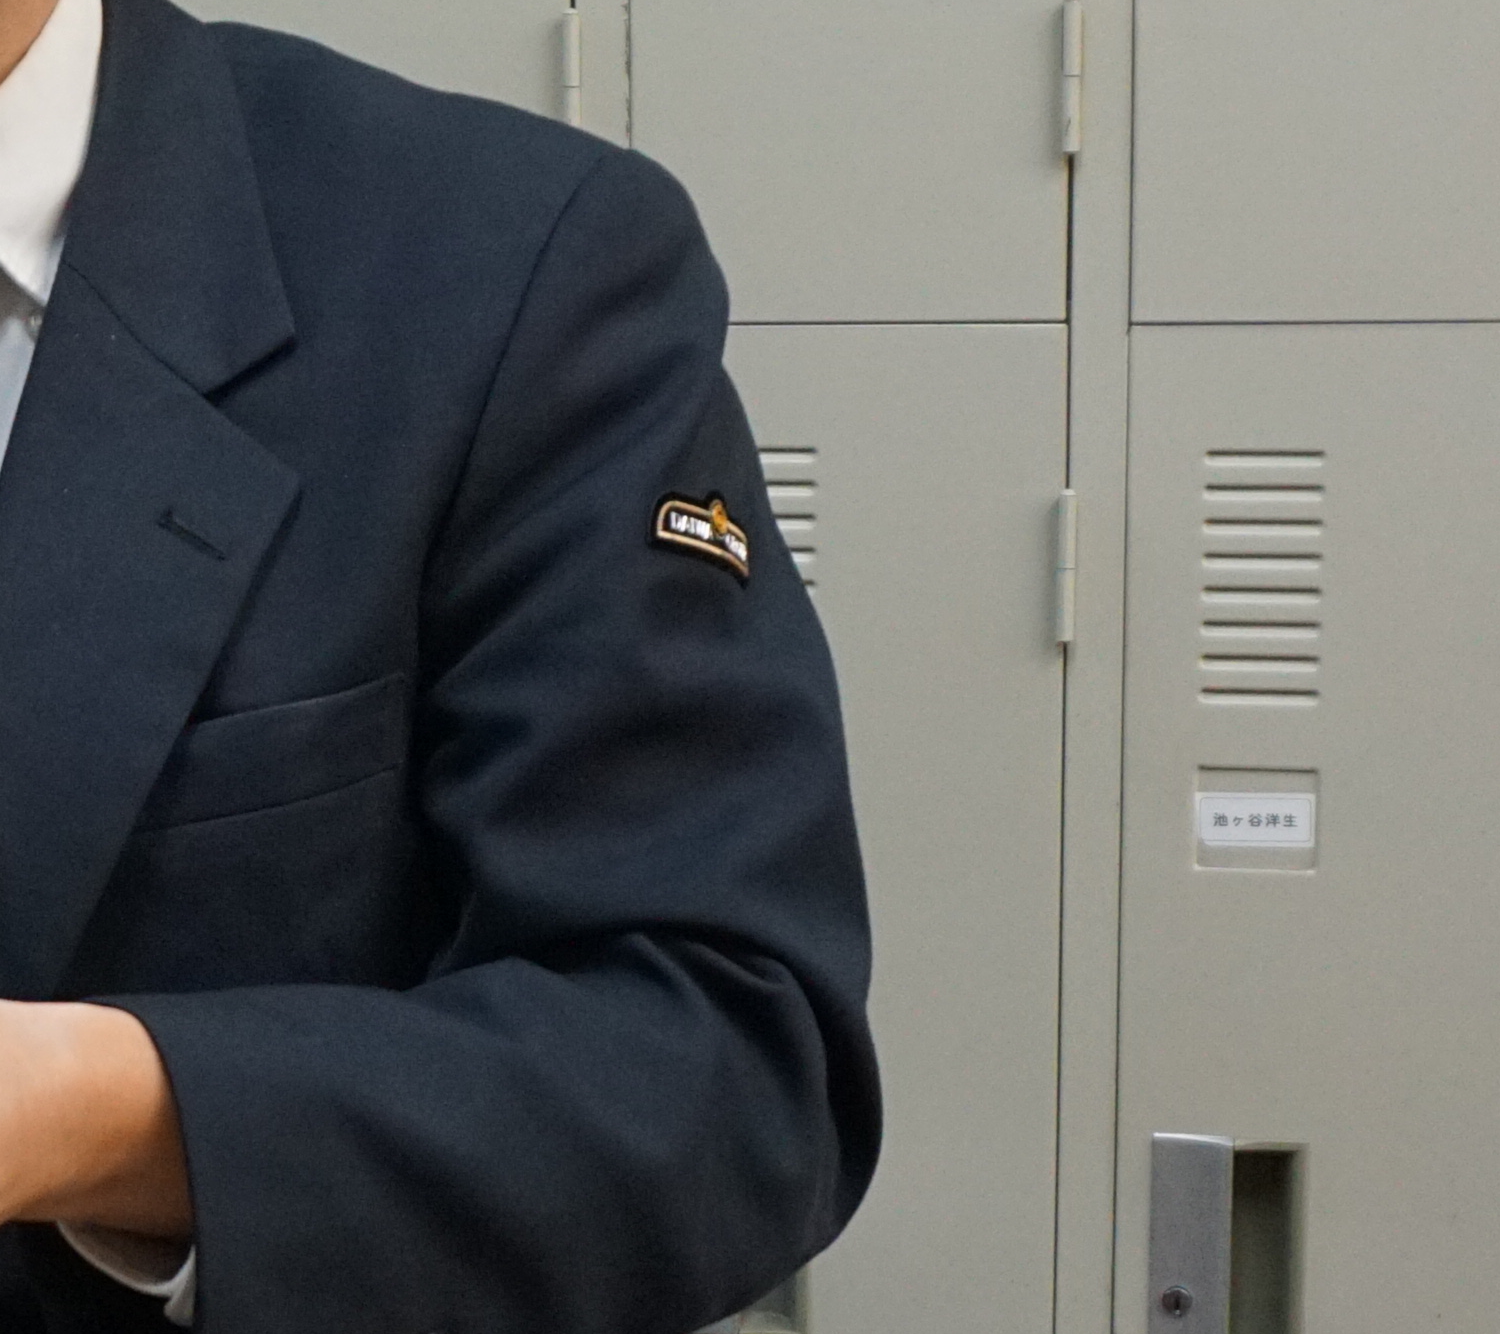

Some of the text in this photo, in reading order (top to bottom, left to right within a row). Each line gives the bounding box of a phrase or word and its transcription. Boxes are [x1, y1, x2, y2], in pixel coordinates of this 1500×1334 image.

[1213, 811, 1299, 829] 池ヶ谷洋生
